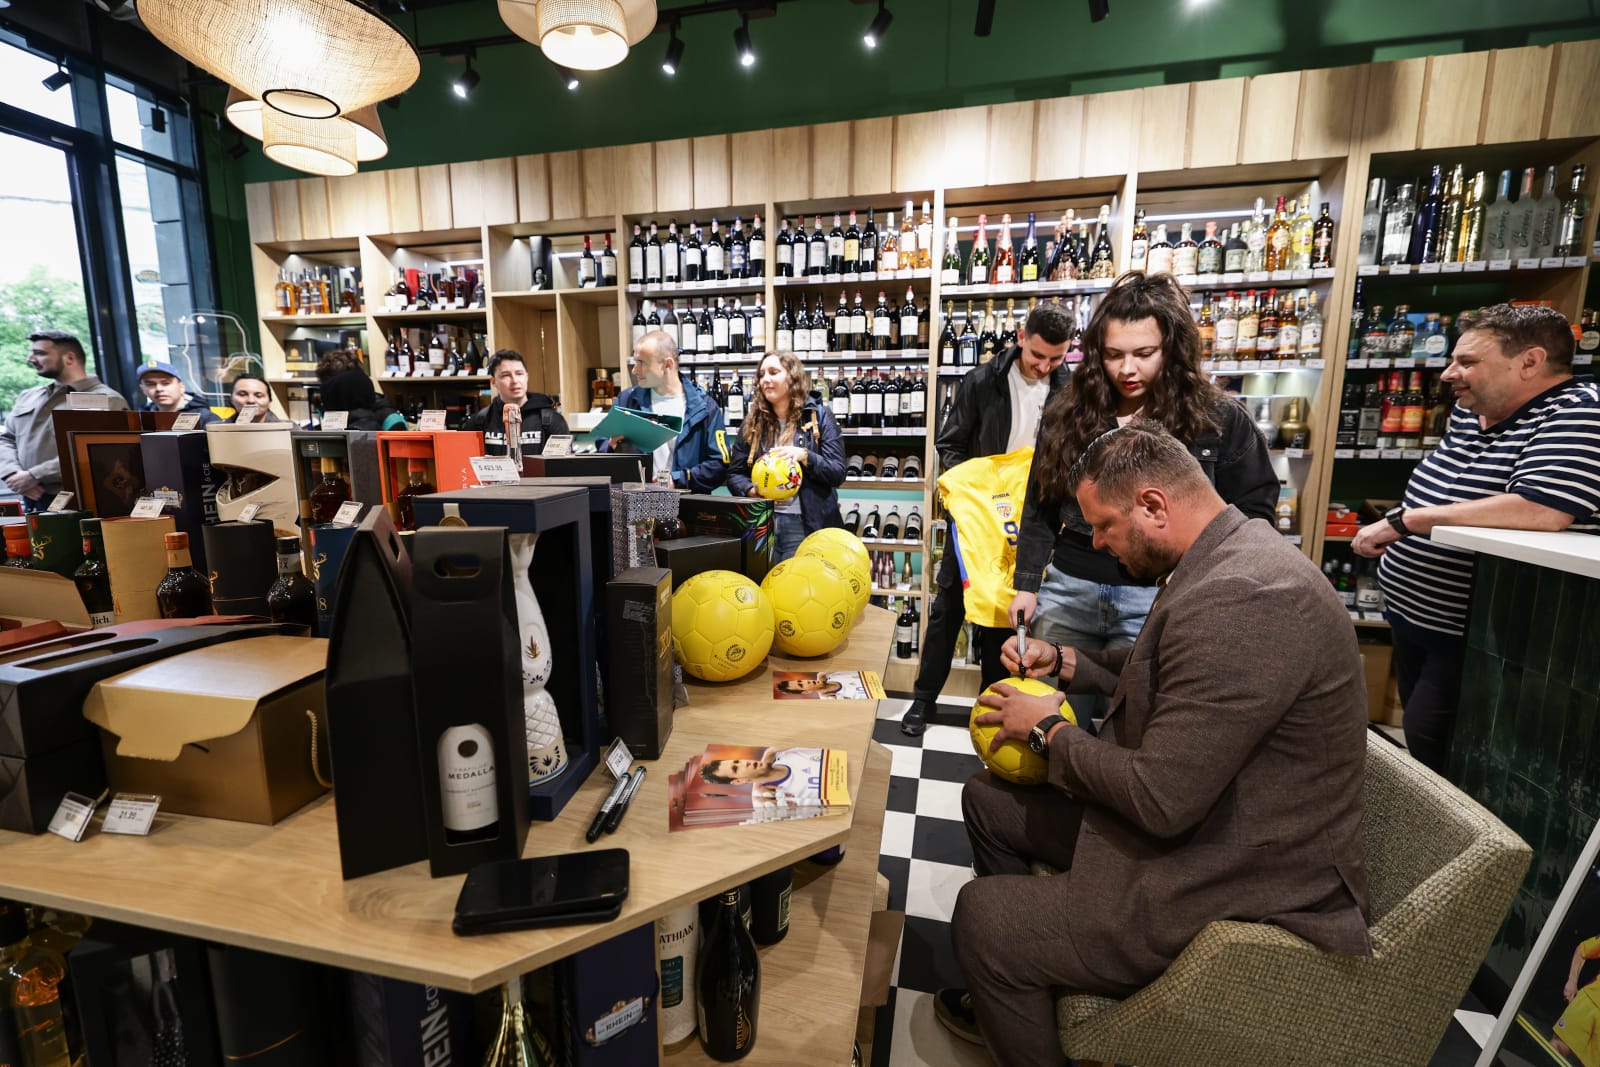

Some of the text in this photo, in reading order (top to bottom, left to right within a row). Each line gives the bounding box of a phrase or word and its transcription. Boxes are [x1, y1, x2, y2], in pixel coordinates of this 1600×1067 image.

[485, 431, 541, 440] ALPETE
[201, 484, 218, 527] HEIN
[1004, 521, 1018, 546] 9
[447, 764, 496, 781] MEDALLA
[659, 922, 694, 945] ATHIAN
[606, 1011, 633, 1031] RHEIN
